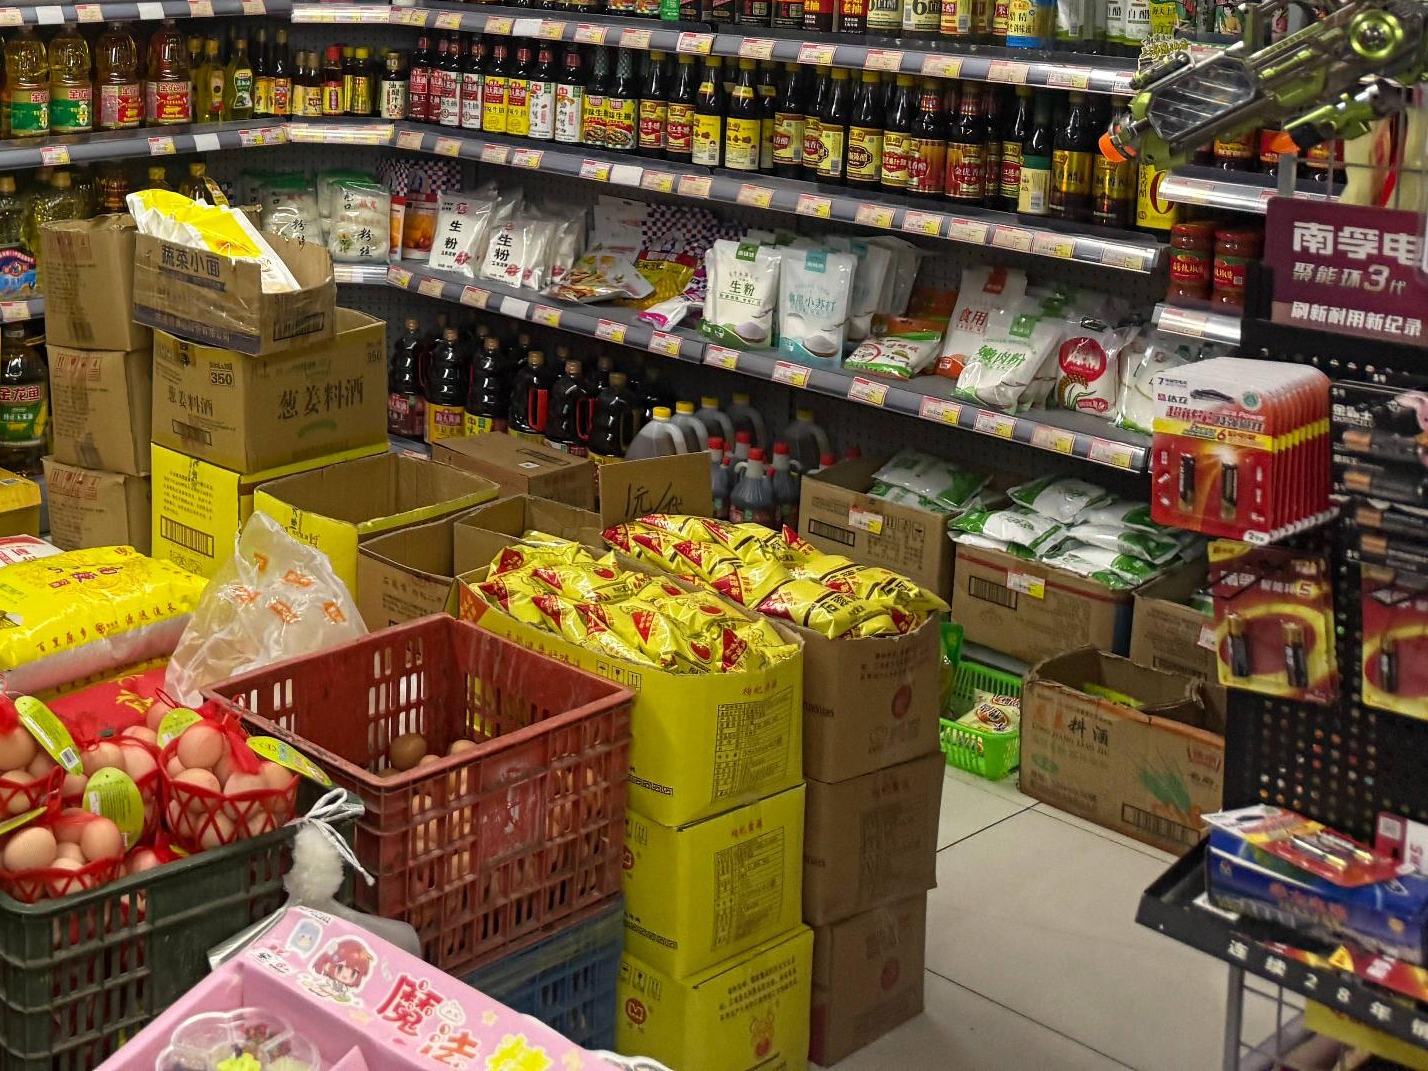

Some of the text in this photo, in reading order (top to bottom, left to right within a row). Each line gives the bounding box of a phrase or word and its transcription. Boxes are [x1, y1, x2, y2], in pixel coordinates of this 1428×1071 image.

[444, 220, 462, 249] 生粉
[493, 233, 512, 261] 生粉
[161, 245, 220, 278] 蔬菜小面
[729, 280, 756, 296] 生粉
[1290, 301, 1422, 337] 刷新耐用新纪录
[210, 370, 233, 386] 350
[1, 386, 40, 401] 金龙鱼
[277, 376, 365, 421] 葱姜料酒
